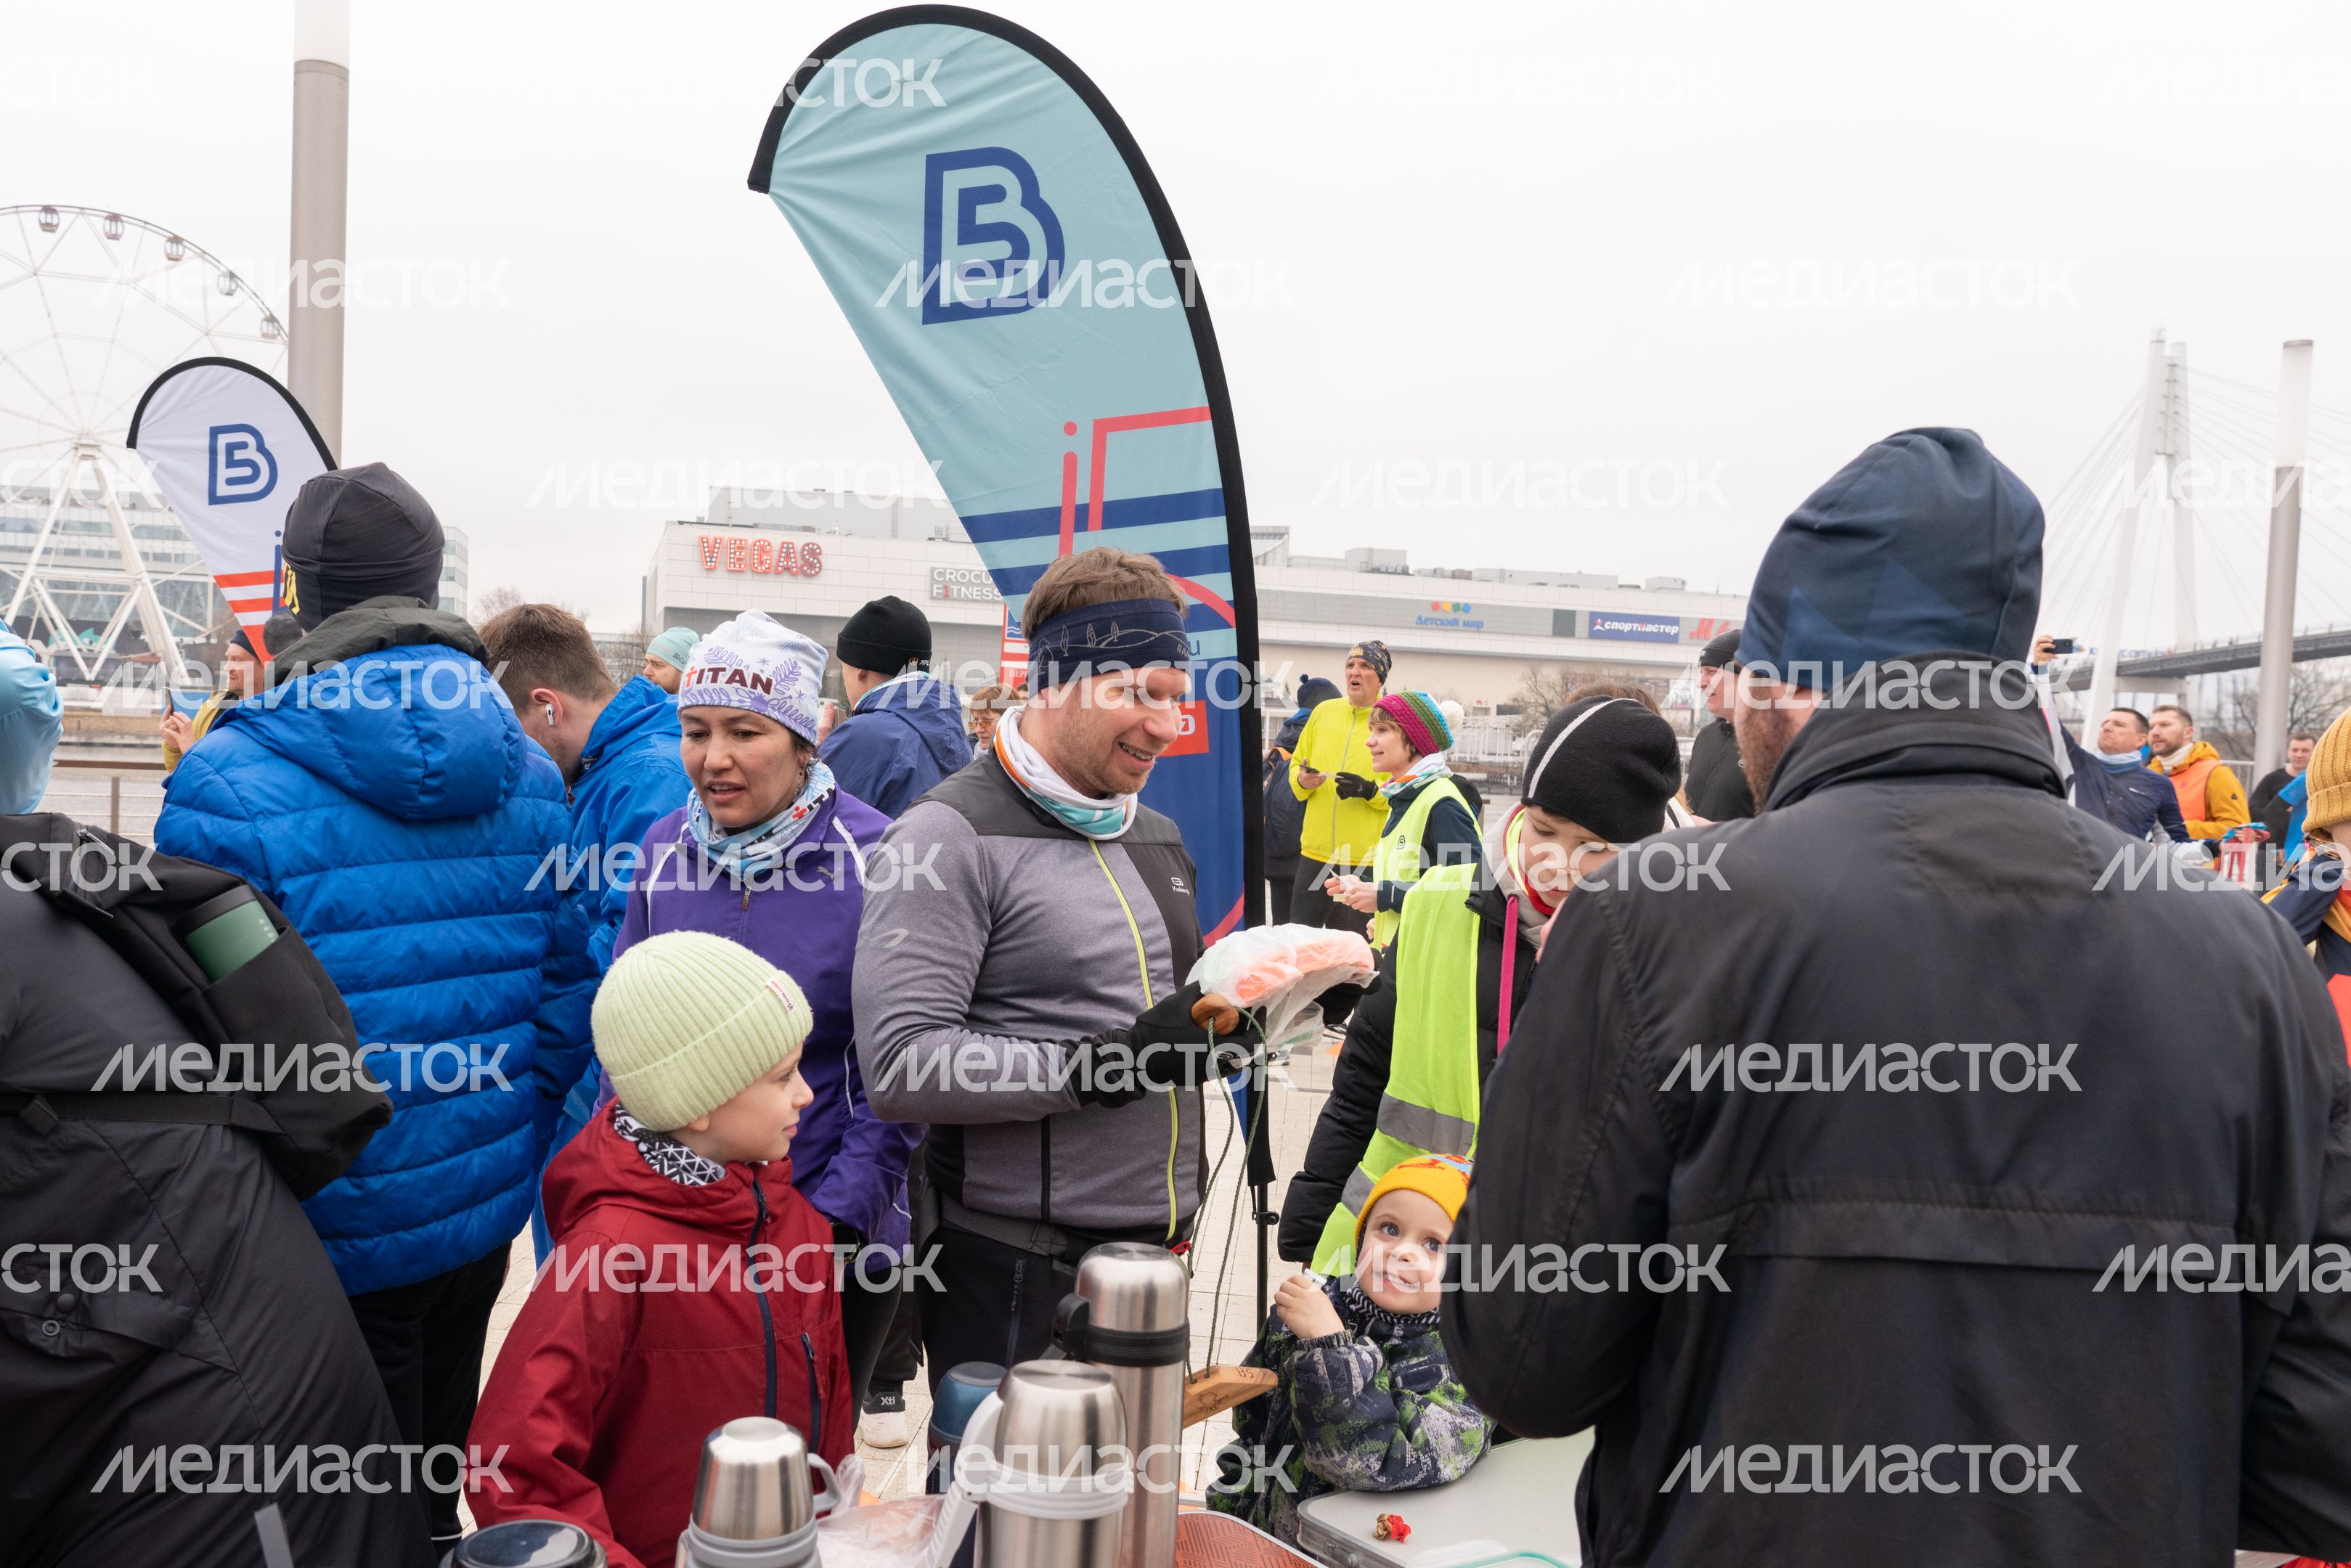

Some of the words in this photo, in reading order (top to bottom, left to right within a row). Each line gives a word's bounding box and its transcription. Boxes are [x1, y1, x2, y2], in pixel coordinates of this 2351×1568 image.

[698, 535, 823, 577] VEGAS
[934, 568, 993, 584] CROCU
[1416, 615, 1459, 626] Детский
[1463, 620, 1484, 631] мир
[1604, 621, 1679, 635] спортмастер
[685, 666, 773, 695] TITAN
[791, 787, 836, 820] TITA
[880, 1396, 895, 1406] Xti
